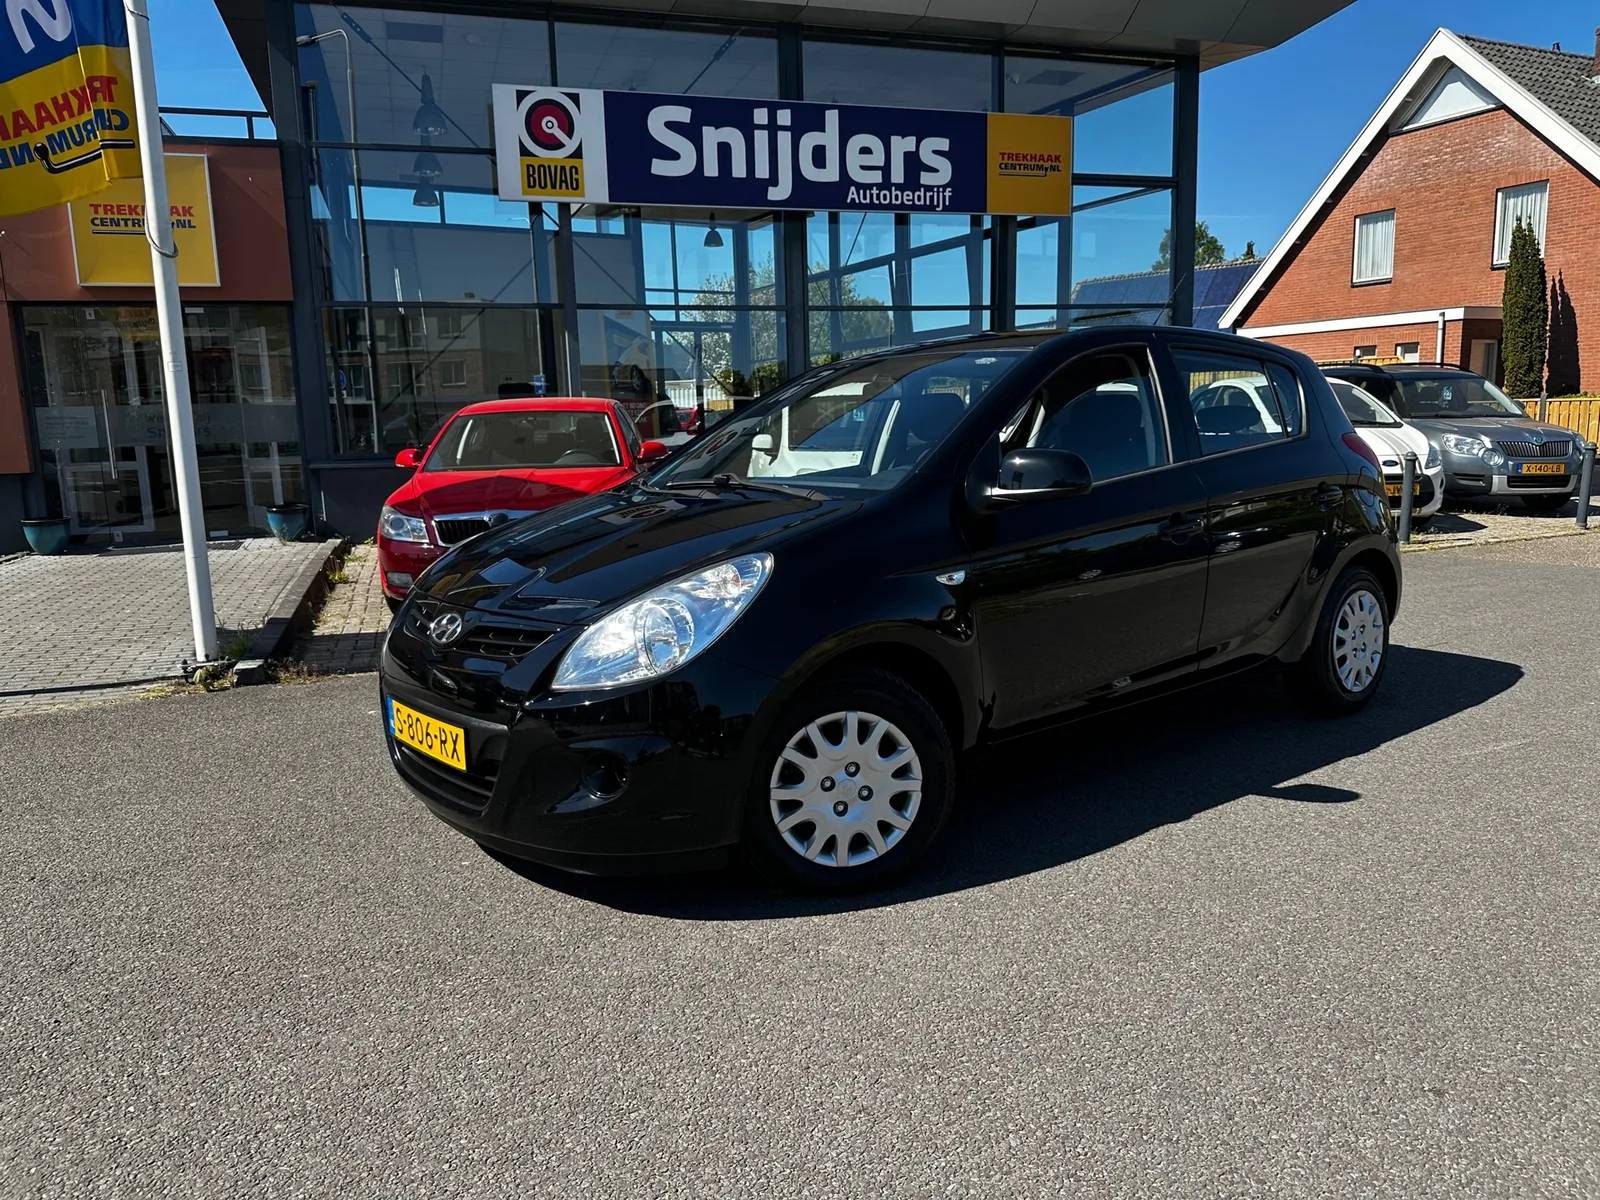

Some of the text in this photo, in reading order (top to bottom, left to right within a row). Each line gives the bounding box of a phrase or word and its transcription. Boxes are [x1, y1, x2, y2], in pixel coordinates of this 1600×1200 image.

[647, 105, 952, 200] Snijders
[999, 152, 1062, 163] TREKHAAK
[526, 164, 580, 191] BOVAG
[847, 186, 952, 211] Autobedrijf
[1525, 464, 1561, 473] X-140-LB
[396, 707, 461, 763] S-806-RX
